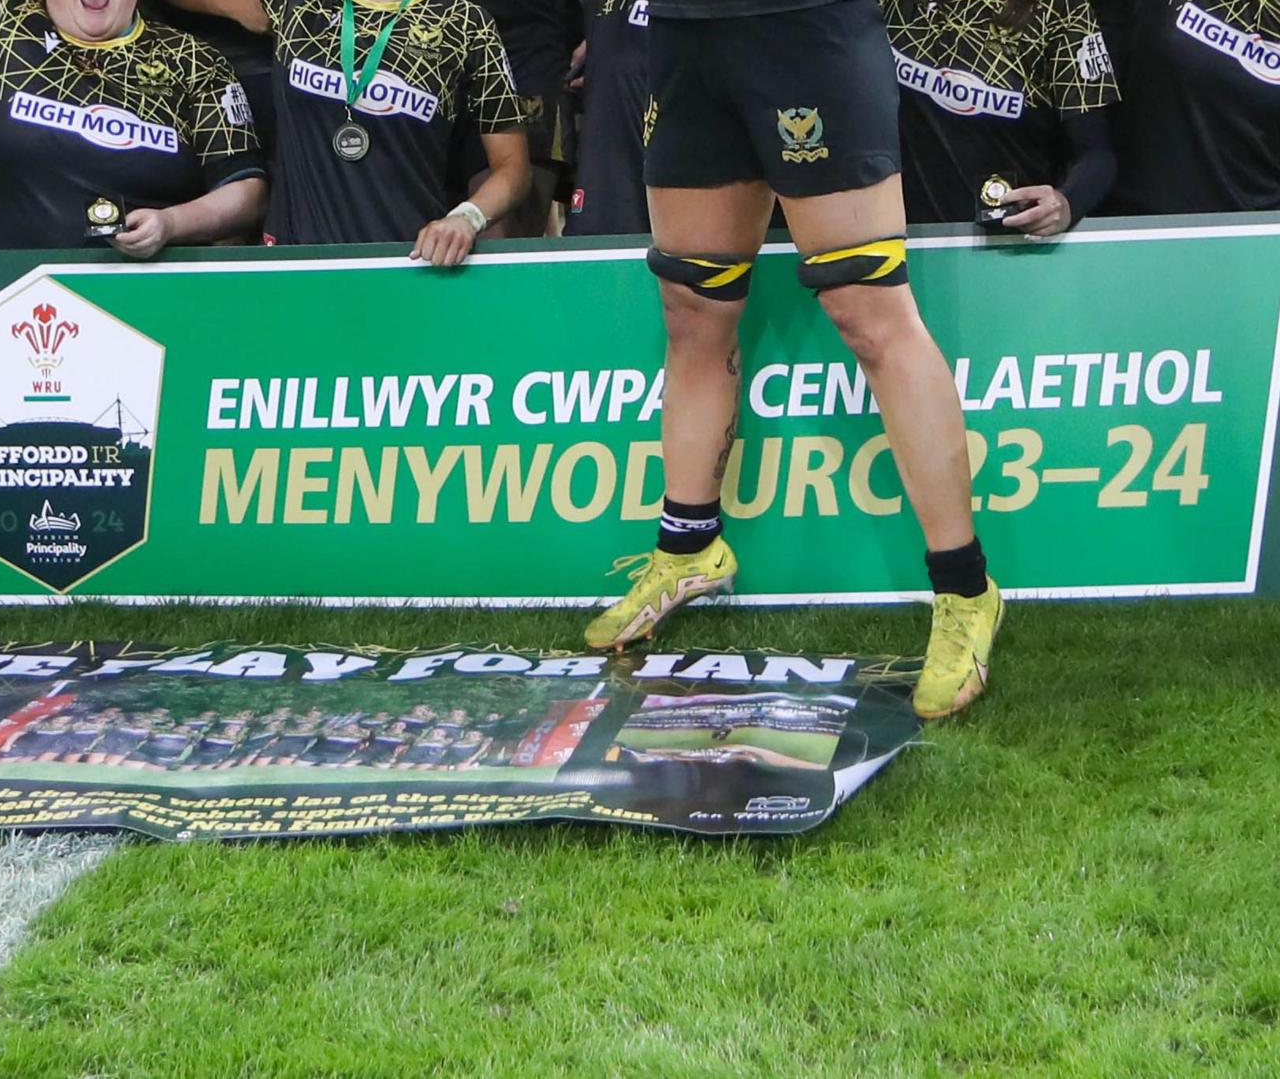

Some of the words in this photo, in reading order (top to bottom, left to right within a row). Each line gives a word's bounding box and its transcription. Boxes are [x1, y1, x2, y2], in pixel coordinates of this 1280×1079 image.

[1180, 8, 1240, 50] HIGH
[291, 65, 342, 94] HIGH
[932, 76, 1020, 115] MOTIVE
[15, 99, 76, 126] HIGH
[81, 114, 176, 148] MOTIVE
[32, 381, 62, 393] WRU
[206, 373, 494, 430] ENILLWYR
[199, 439, 667, 525] MENYWOD
[720, 432, 902, 521] URC
[92, 510, 125, 532] 24
[26, 542, 87, 557] Principality
[81, 650, 378, 681] PLAY
[388, 651, 609, 681] FOR
[631, 653, 856, 683] IAN
[170, 797, 287, 808] without
[292, 796, 342, 806] Ian
[350, 794, 388, 804] on
[396, 793, 446, 803] the
[271, 804, 424, 819] supporter
[128, 809, 184, 828] our
[186, 819, 282, 831] North
